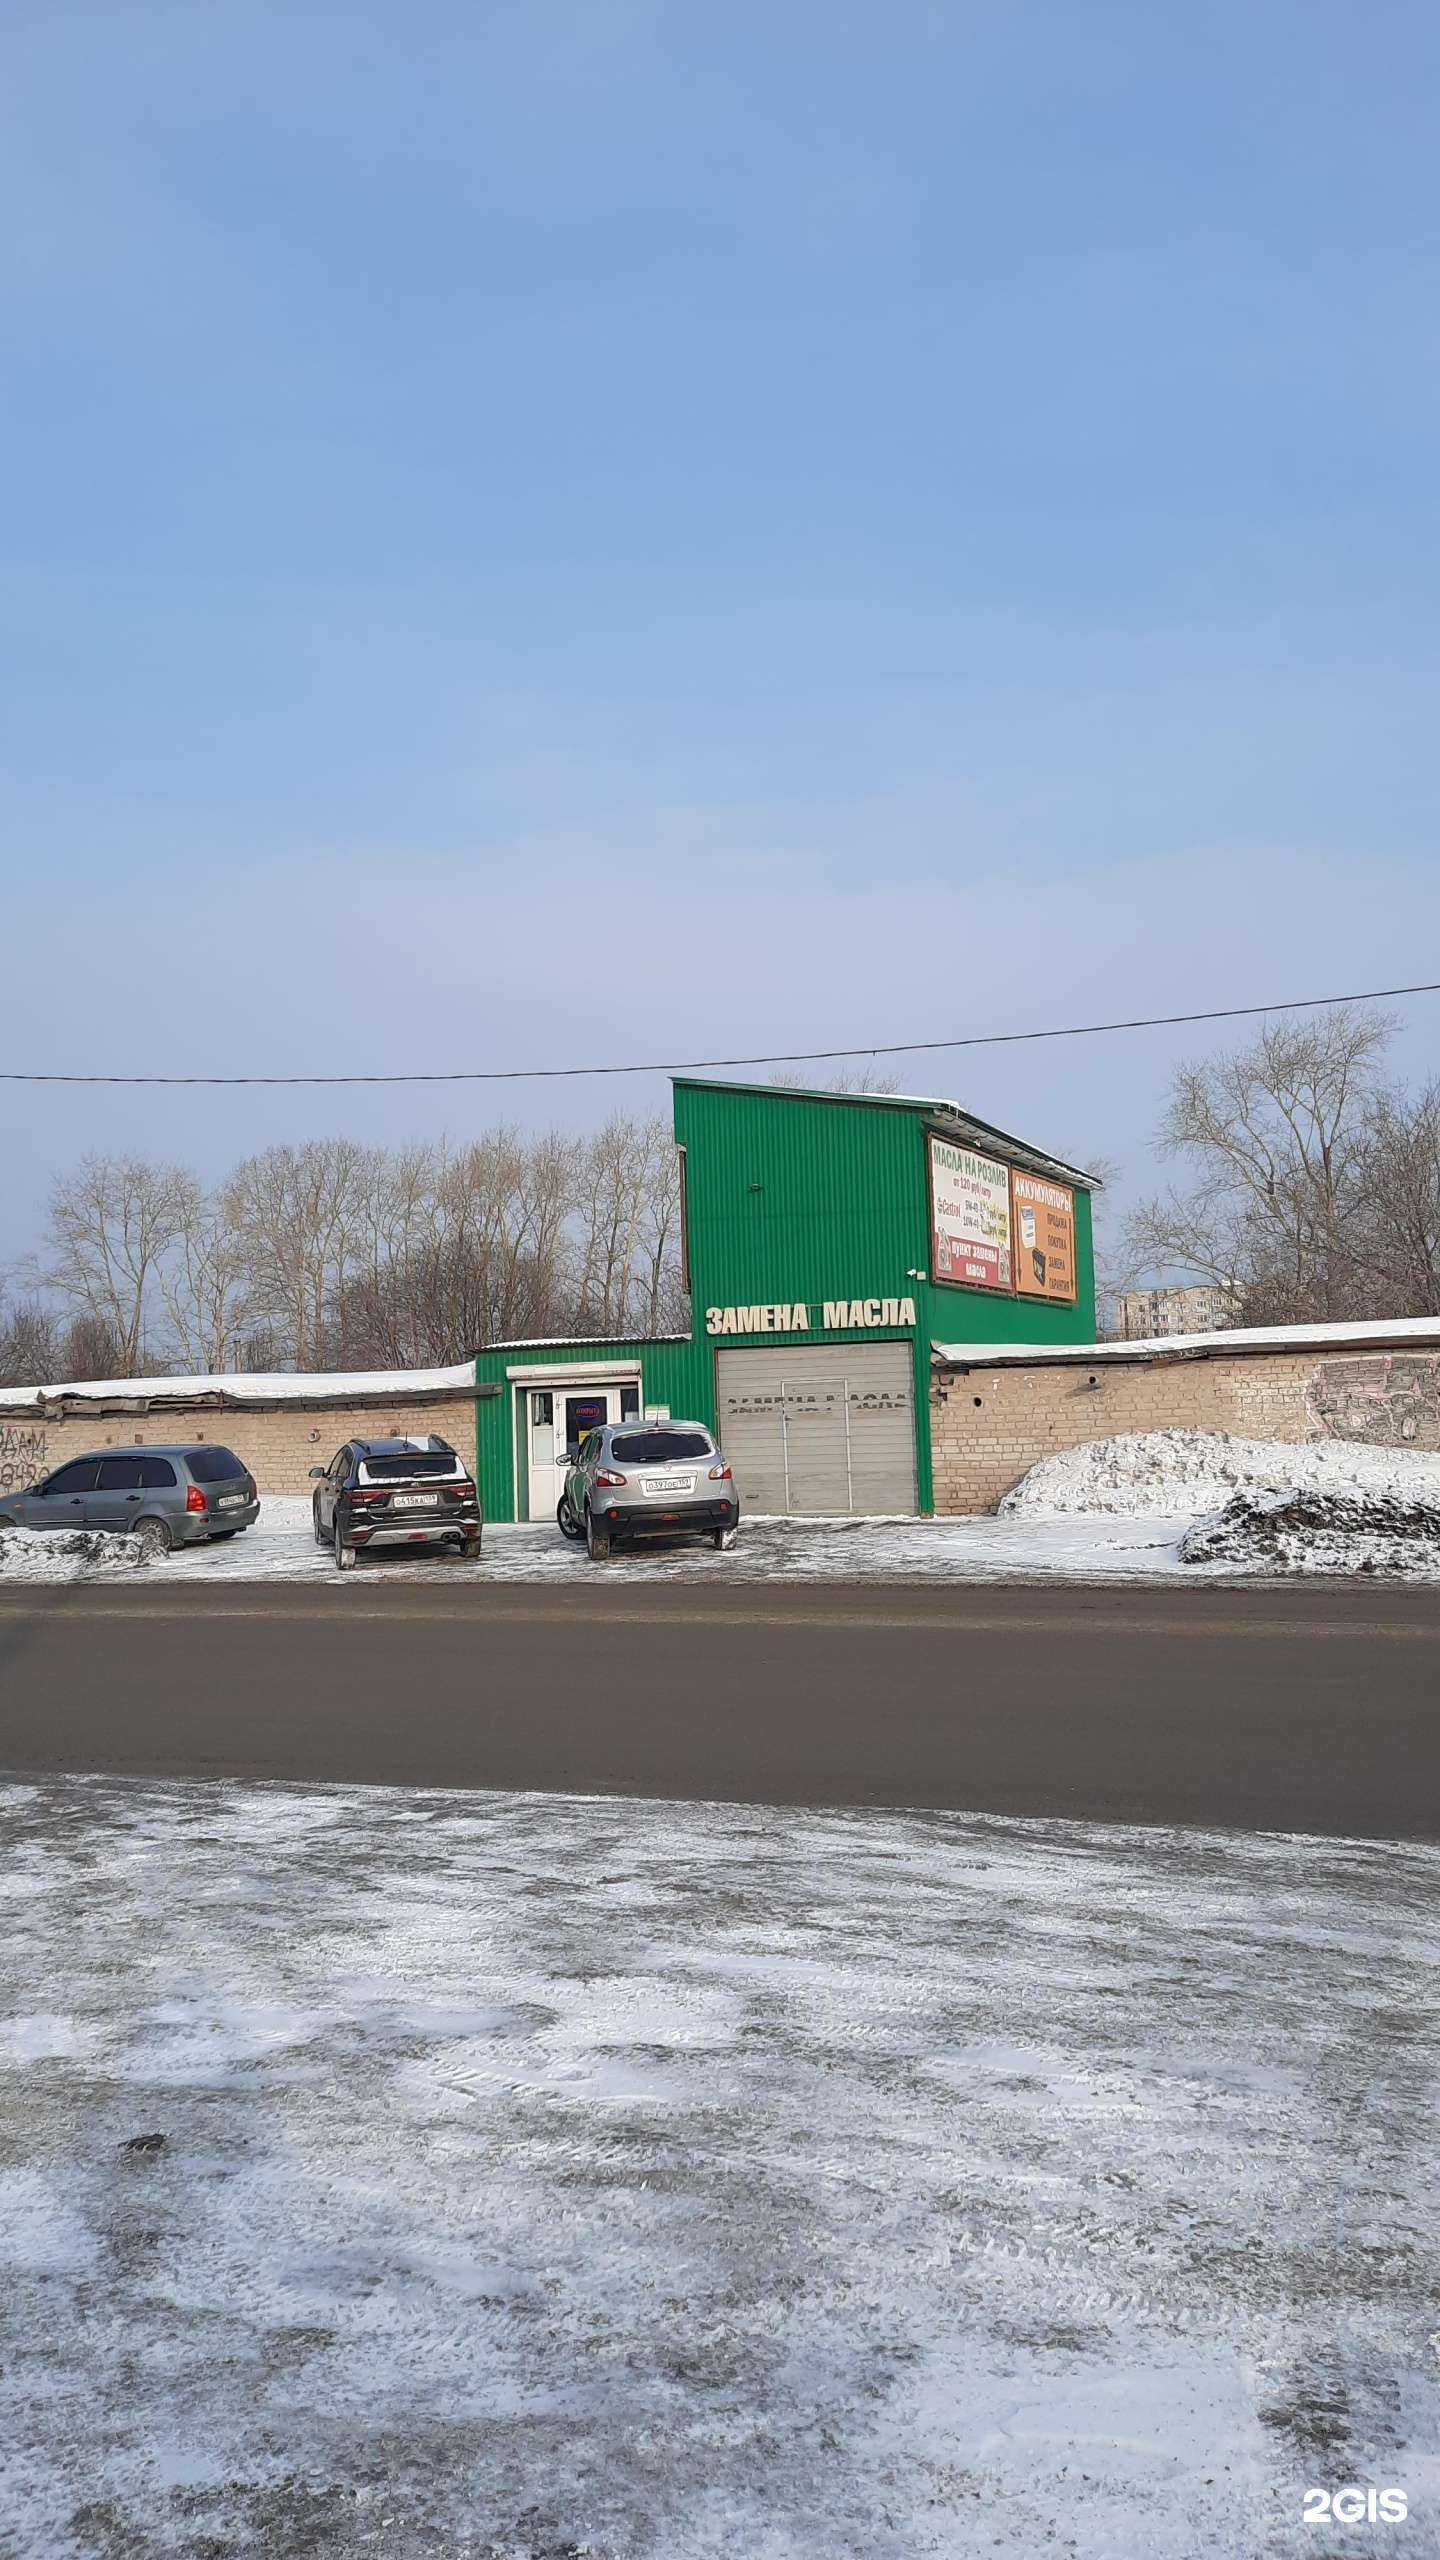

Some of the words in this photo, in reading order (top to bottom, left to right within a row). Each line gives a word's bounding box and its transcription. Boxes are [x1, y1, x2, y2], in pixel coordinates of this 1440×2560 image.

[933, 1144, 963, 1173] МАСЛА
[965, 1155, 977, 1178] НА
[977, 1160, 1007, 1188] РОЗЛИВ
[1015, 1177, 1073, 1212] АККУМУЛЯТОРЫ
[706, 1303, 810, 1335] ЗАМЕНА
[823, 1297, 917, 1329] МАСЛА
